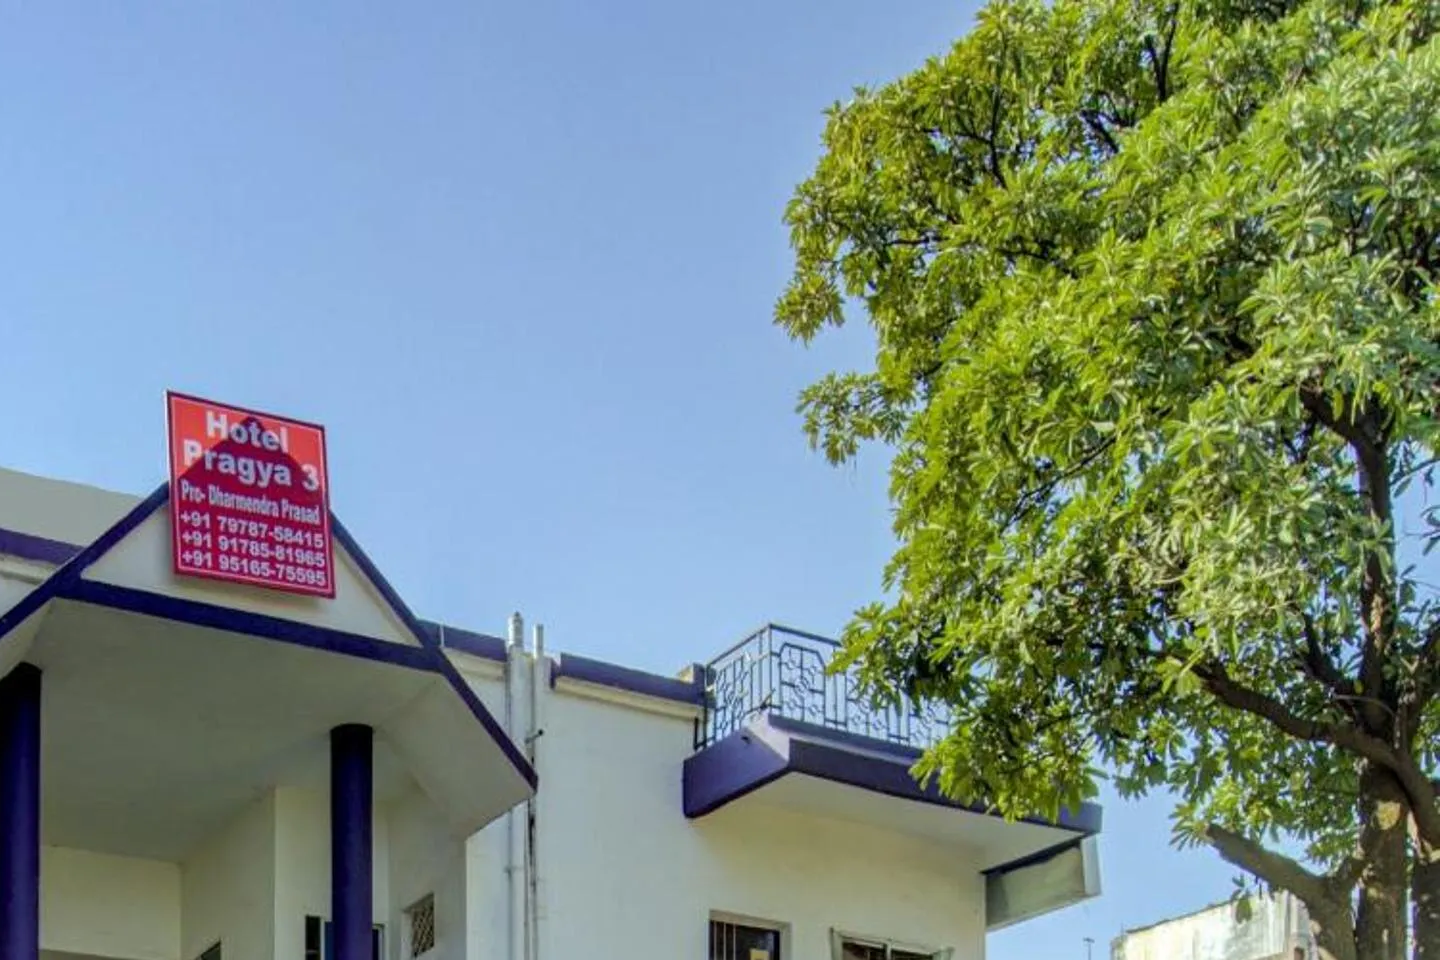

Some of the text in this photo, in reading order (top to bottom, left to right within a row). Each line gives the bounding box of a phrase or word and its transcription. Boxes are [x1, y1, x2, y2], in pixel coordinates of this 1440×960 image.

[206, 411, 289, 453] Hotel
[183, 439, 320, 491] Pragya 3
[209, 484, 279, 517] Dharmendra
[281, 499, 321, 524] Prasad
[181, 511, 323, 548] +91 79787-58415
[182, 531, 325, 567] +91 91785-81965
[182, 552, 326, 586] +91 95165-75595
